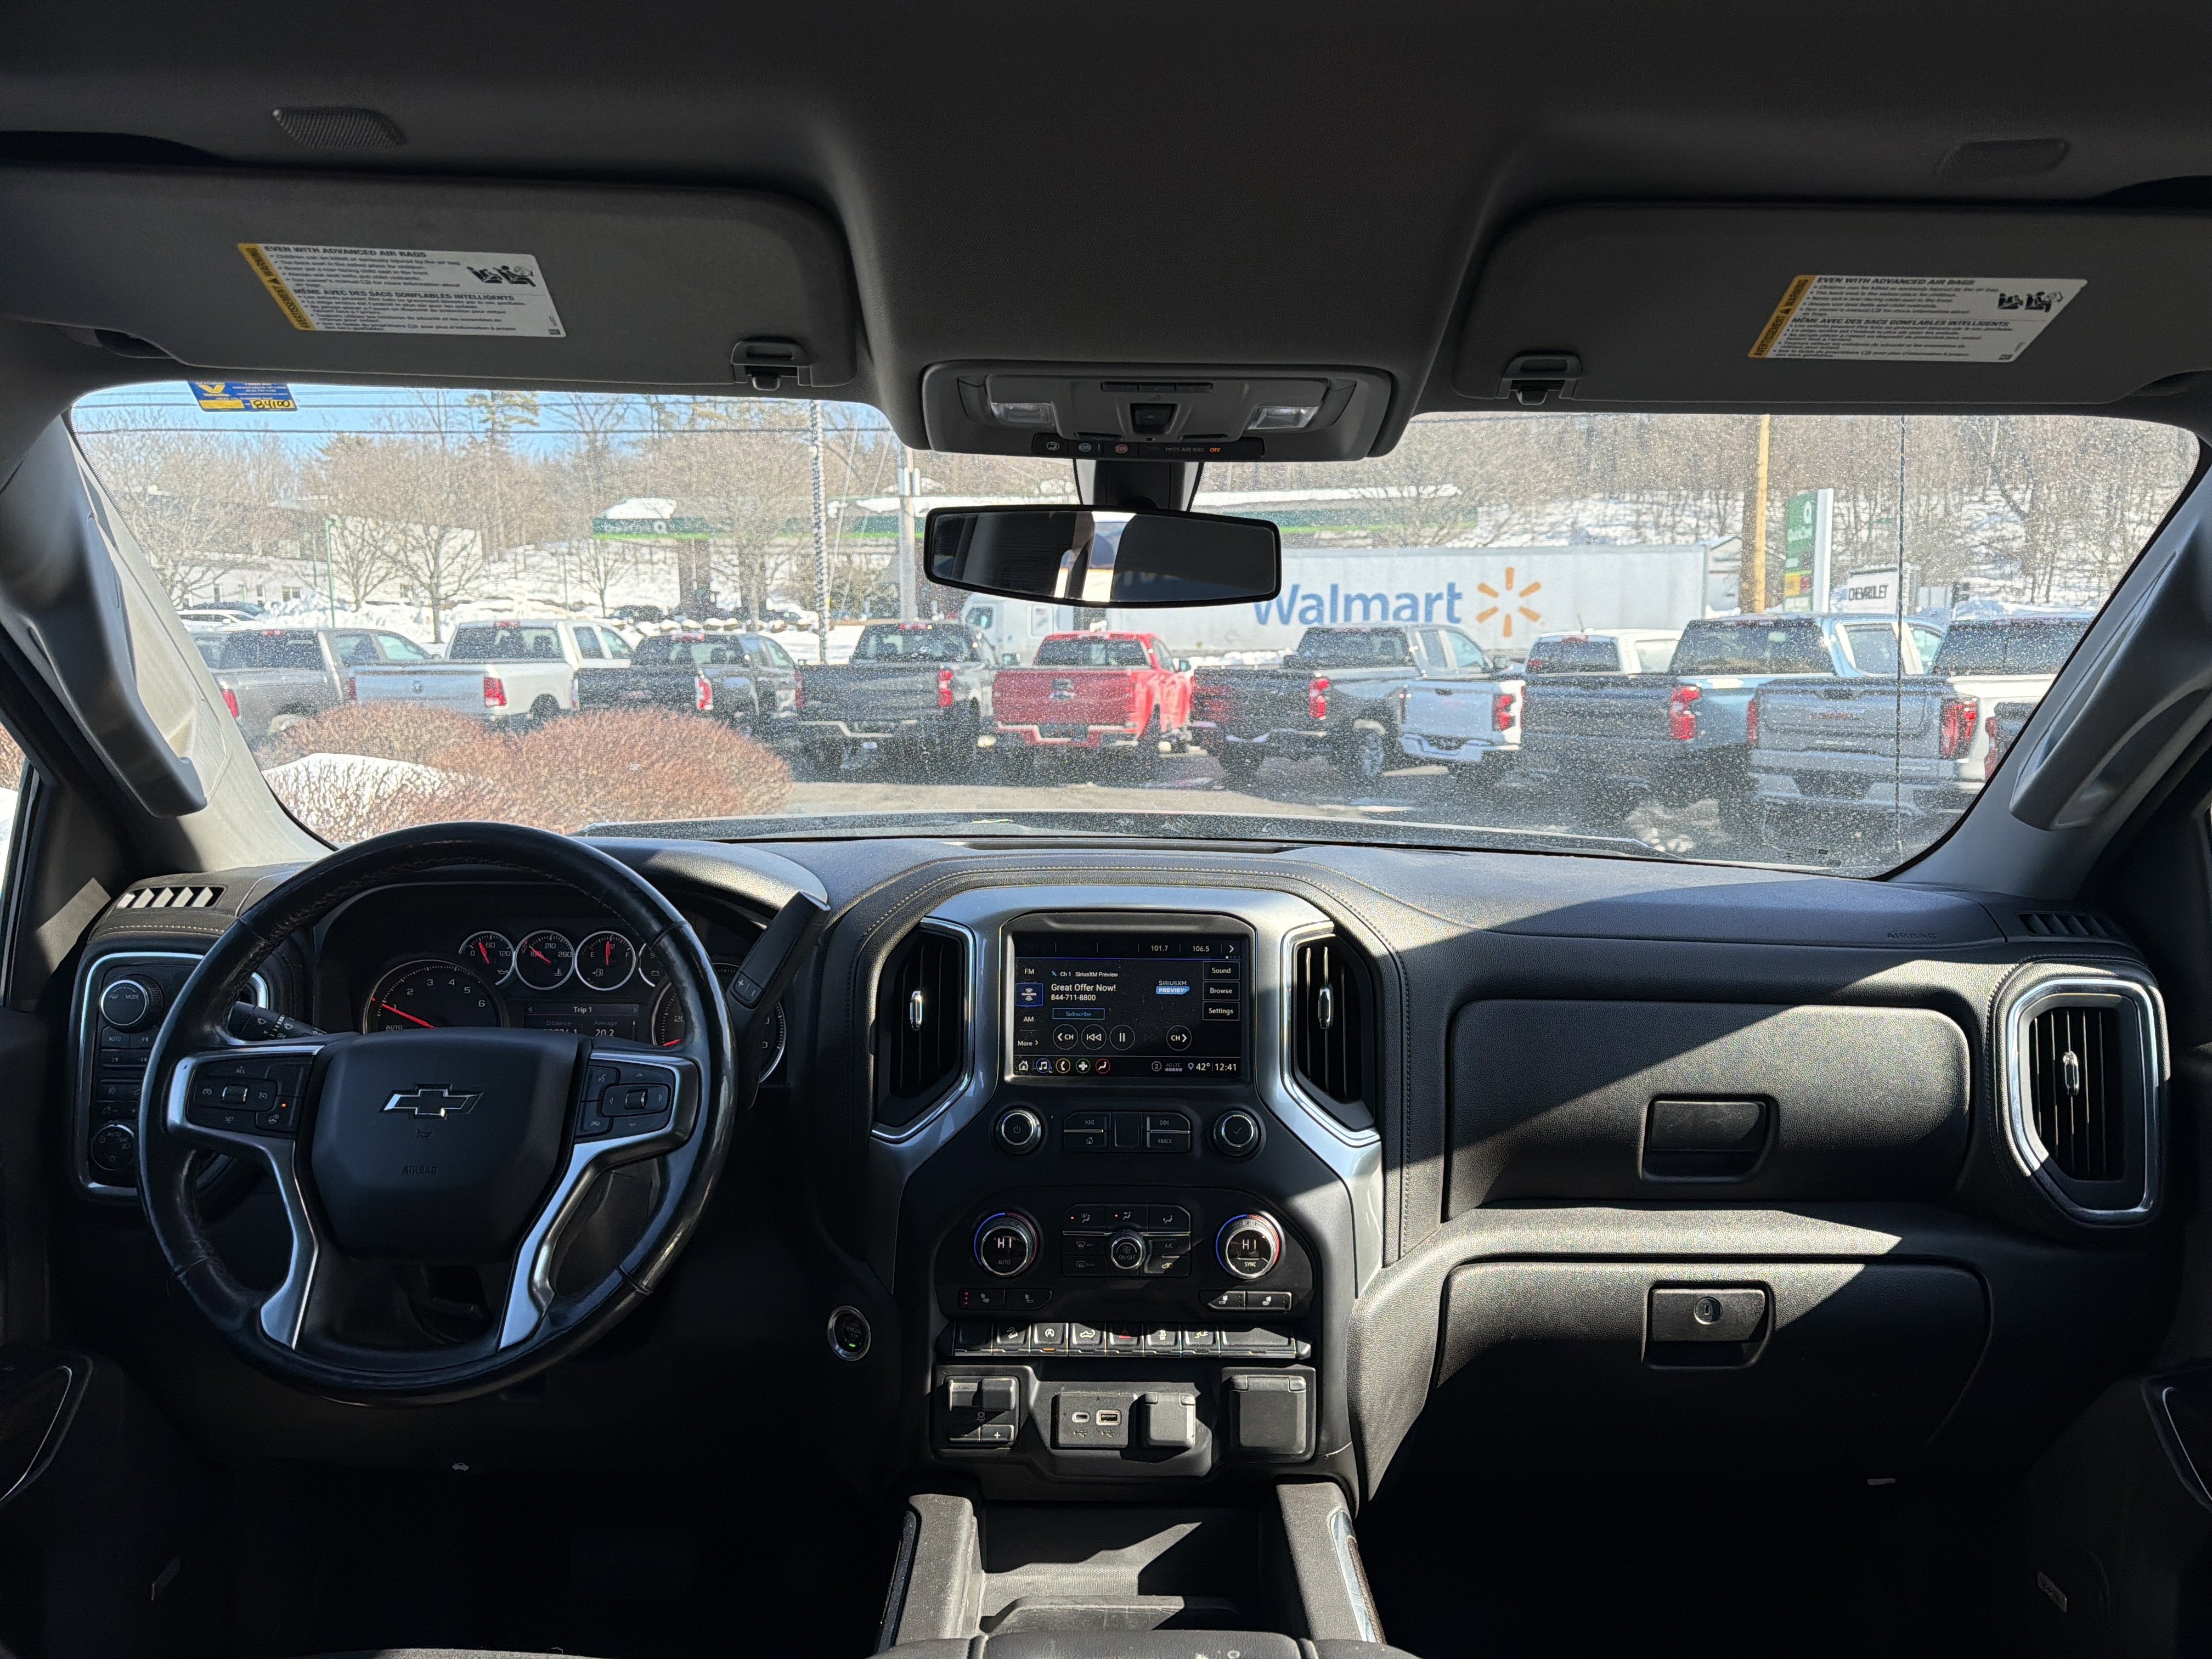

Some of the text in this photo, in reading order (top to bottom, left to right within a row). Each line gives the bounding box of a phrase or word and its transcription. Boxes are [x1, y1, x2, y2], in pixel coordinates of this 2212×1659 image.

[323, 246, 377, 256] ADVANCED
[245, 247, 275, 276] WARNING
[1784, 279, 1809, 307] WARNING
[1753, 315, 1786, 356] AVERTISSEMENT
[1254, 582, 1463, 626] Walmart
[406, 988, 414, 996] 2
[1051, 983, 1116, 992] Great Offer Now!
[573, 1006, 587, 1014] Trip
[1208, 1007, 1234, 1016] Settings
[595, 1029, 615, 1037] 20.2
[1195, 1062, 1211, 1071] 42°
[1214, 1063, 1237, 1071] 12:41
[403, 1165, 437, 1175] AIRBAG
